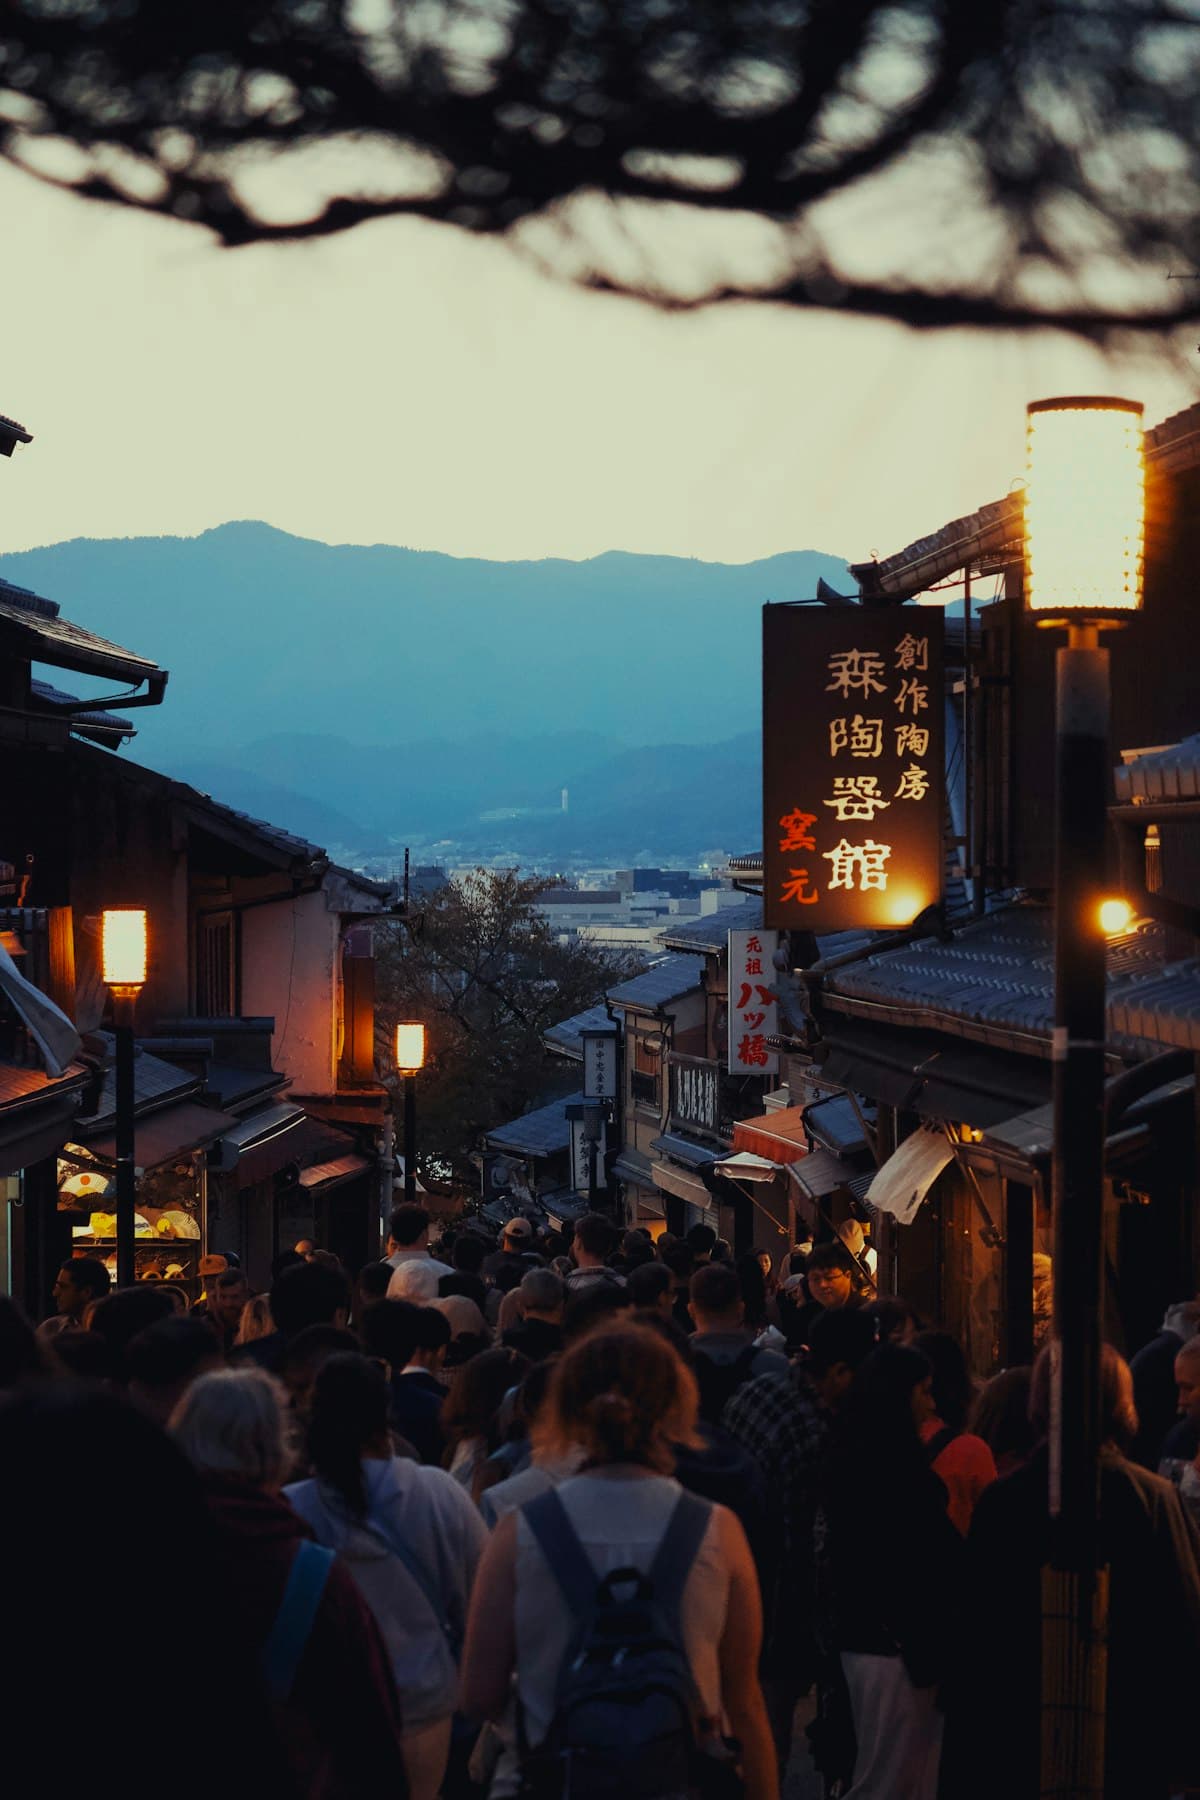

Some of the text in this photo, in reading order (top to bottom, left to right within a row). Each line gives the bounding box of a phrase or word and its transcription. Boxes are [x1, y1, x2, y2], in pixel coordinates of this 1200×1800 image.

[821, 647, 892, 892] 森陶器館
[893, 632, 930, 801] 創作陶房
[778, 807, 819, 906] 窯元
